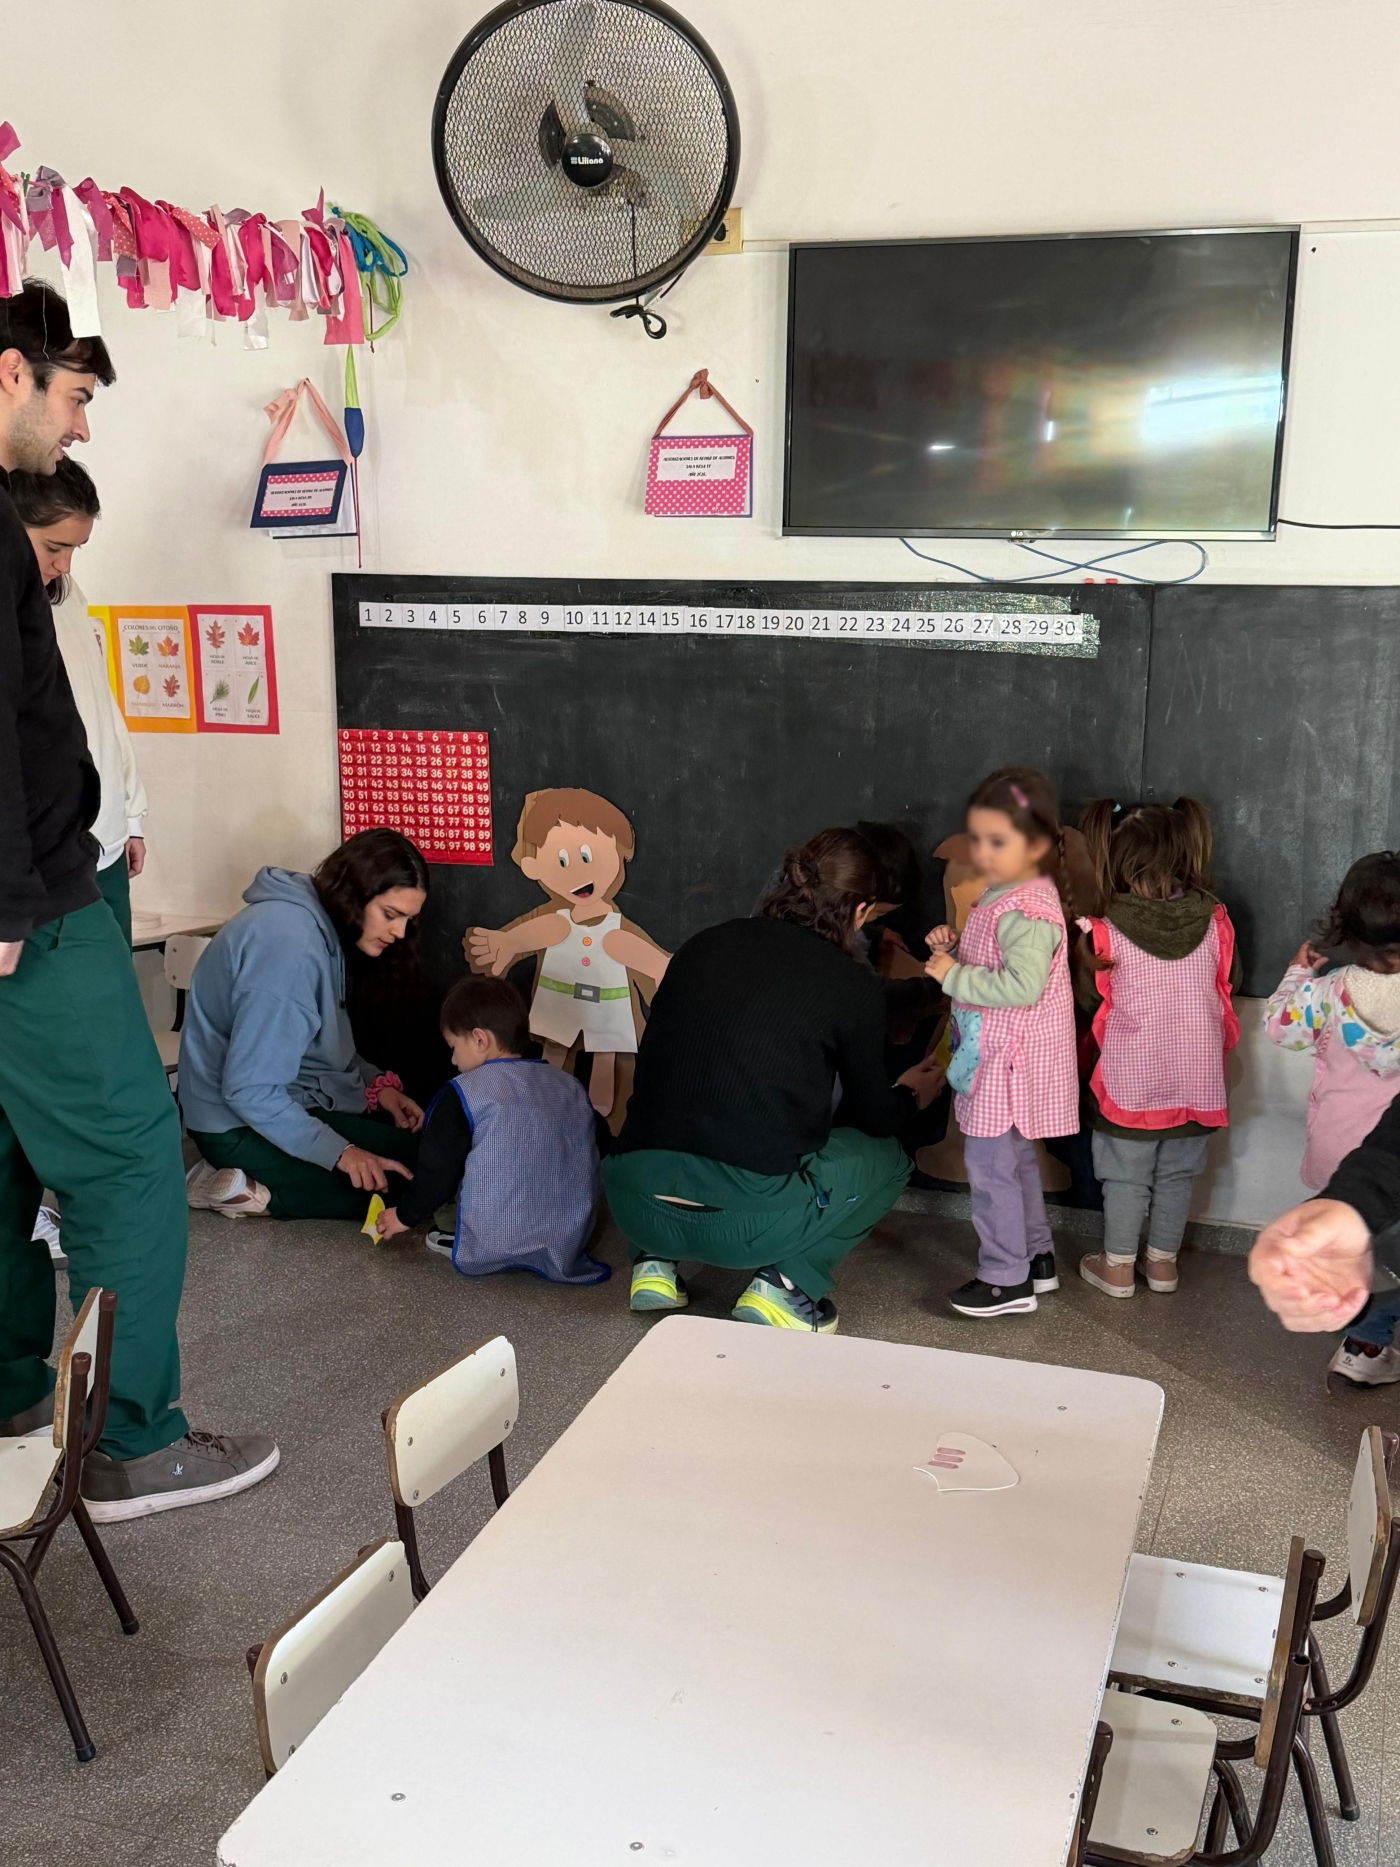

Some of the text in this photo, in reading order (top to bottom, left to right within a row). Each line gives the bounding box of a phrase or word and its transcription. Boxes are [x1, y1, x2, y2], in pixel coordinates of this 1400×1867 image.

[577, 156, 604, 165] Liliana
[365, 609, 1075, 635] 1 2 3 4 5 6 7 8 9 10 11 12 14 15 16 17 18 19 20 21 22 23 24 25 26 27 28 29 30
[343, 730, 483, 742] 0 1 2 3 4 5 6 7 8 9
[342, 742, 486, 755] 10 11 12 13 14 15 16 17 18 19
[342, 754, 487, 767] 20 21 22 23 24 25 26 27 28 29
[343, 766, 488, 779] 30 31 32 33 34 35 36 37 38 39
[342, 778, 488, 791] 40 41 42 43 44 45 46 47 48 49
[344, 790, 489, 803] 50 51 52 53 54 55 56 57 58 59
[344, 802, 489, 815] 60 61 62 63 64 65 66 67 68 69
[345, 814, 490, 827] 70 71 72 73 74 75 76 77 78 79
[345, 825, 356, 834] 80
[404, 827, 415, 836] 84
[419, 828, 430, 837] 85
[434, 829, 445, 838] 86
[448, 829, 460, 838] 87
[464, 830, 475, 839] 88
[479, 830, 490, 839] 89
[419, 840, 490, 851] 95 96 97 98 99
